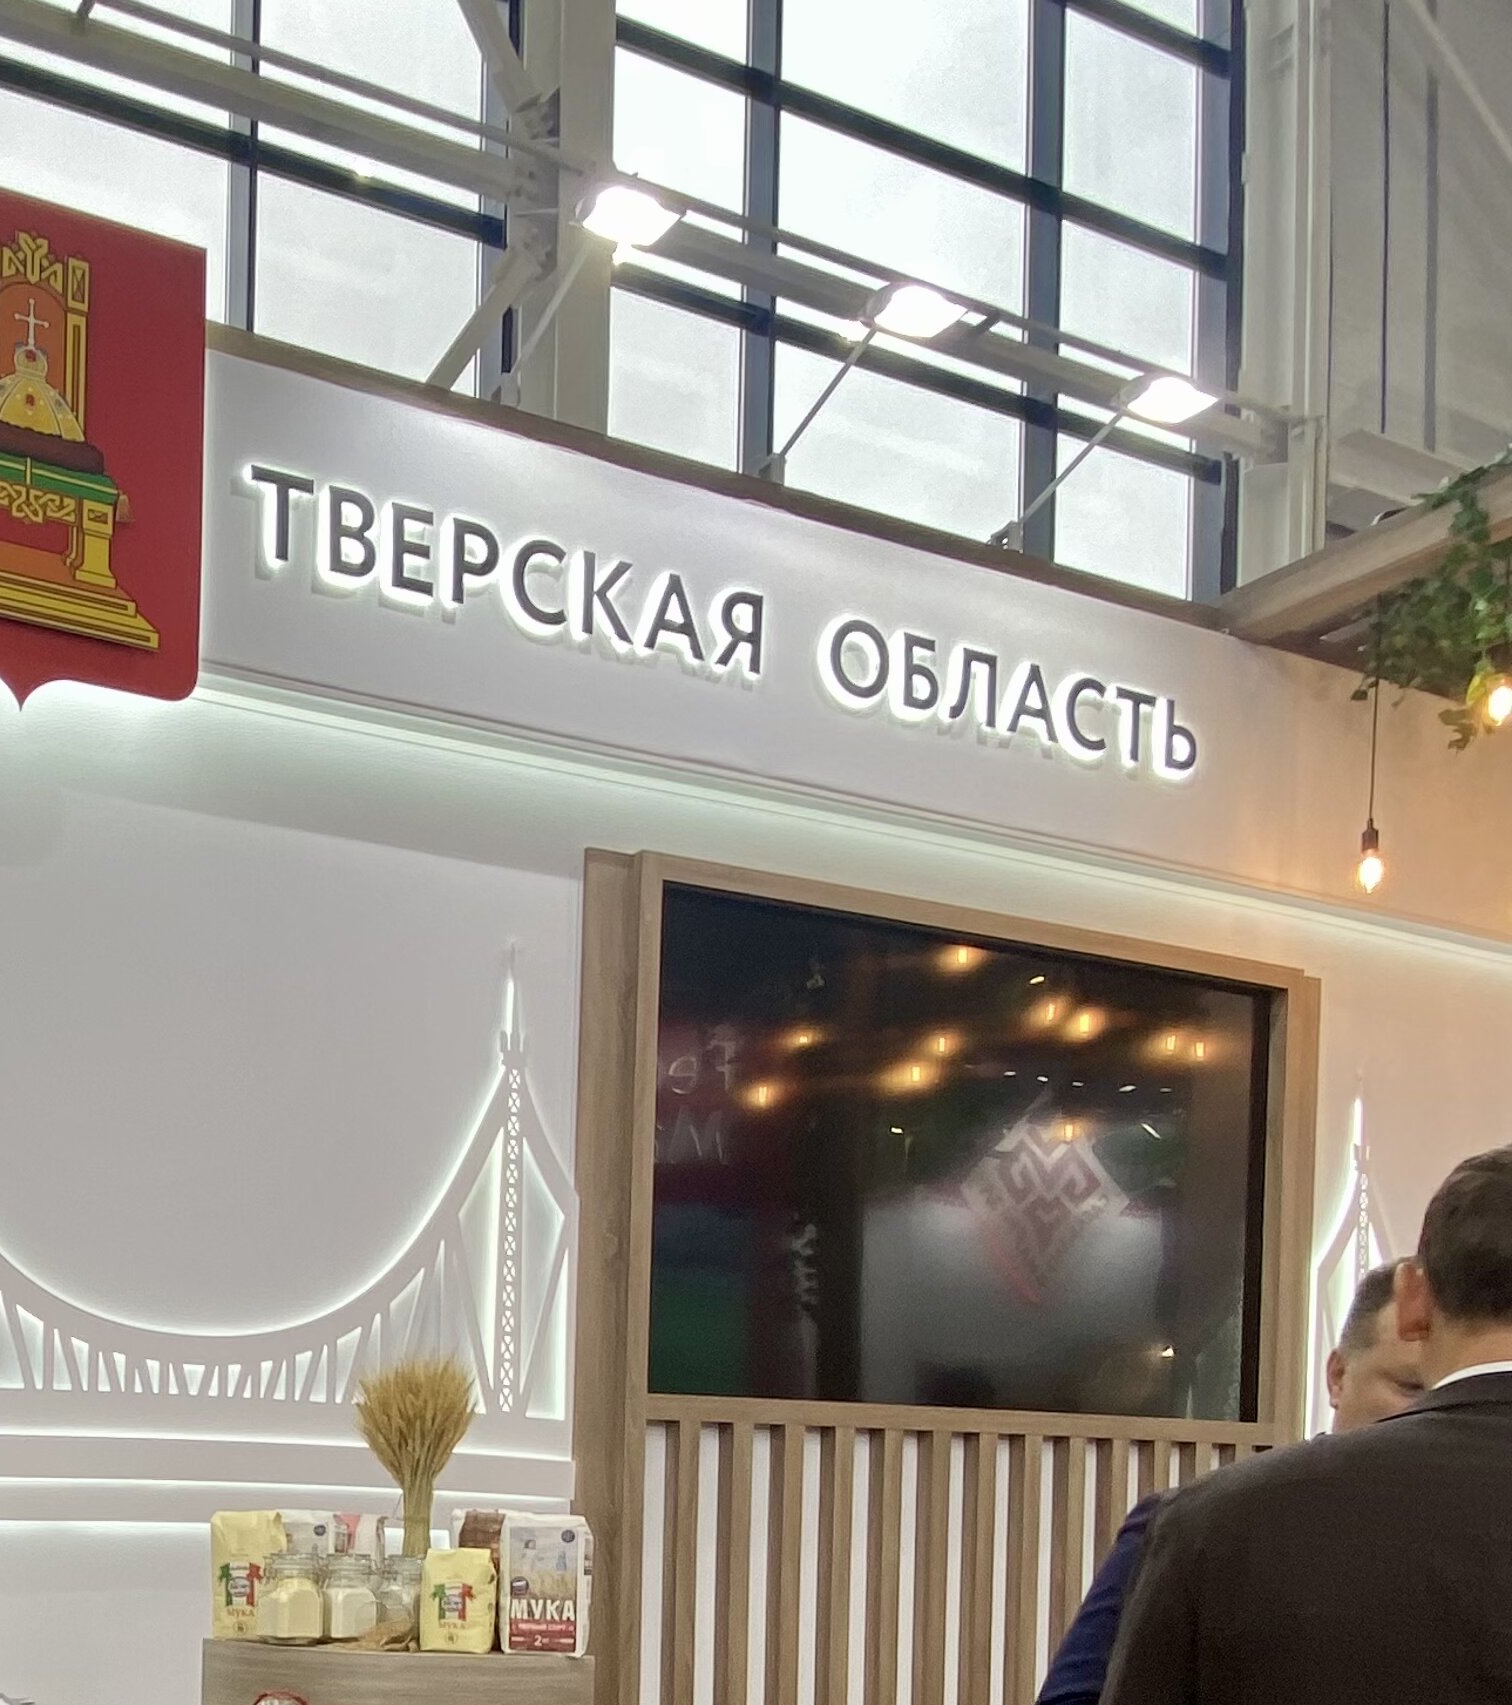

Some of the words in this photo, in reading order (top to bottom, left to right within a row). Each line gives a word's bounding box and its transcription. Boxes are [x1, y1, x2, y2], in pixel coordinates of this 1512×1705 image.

[249, 463, 765, 677] ТВЕРСКАЯ
[830, 616, 1198, 773] ОБЛАСТЬ
[510, 1598, 575, 1621] МУКА
